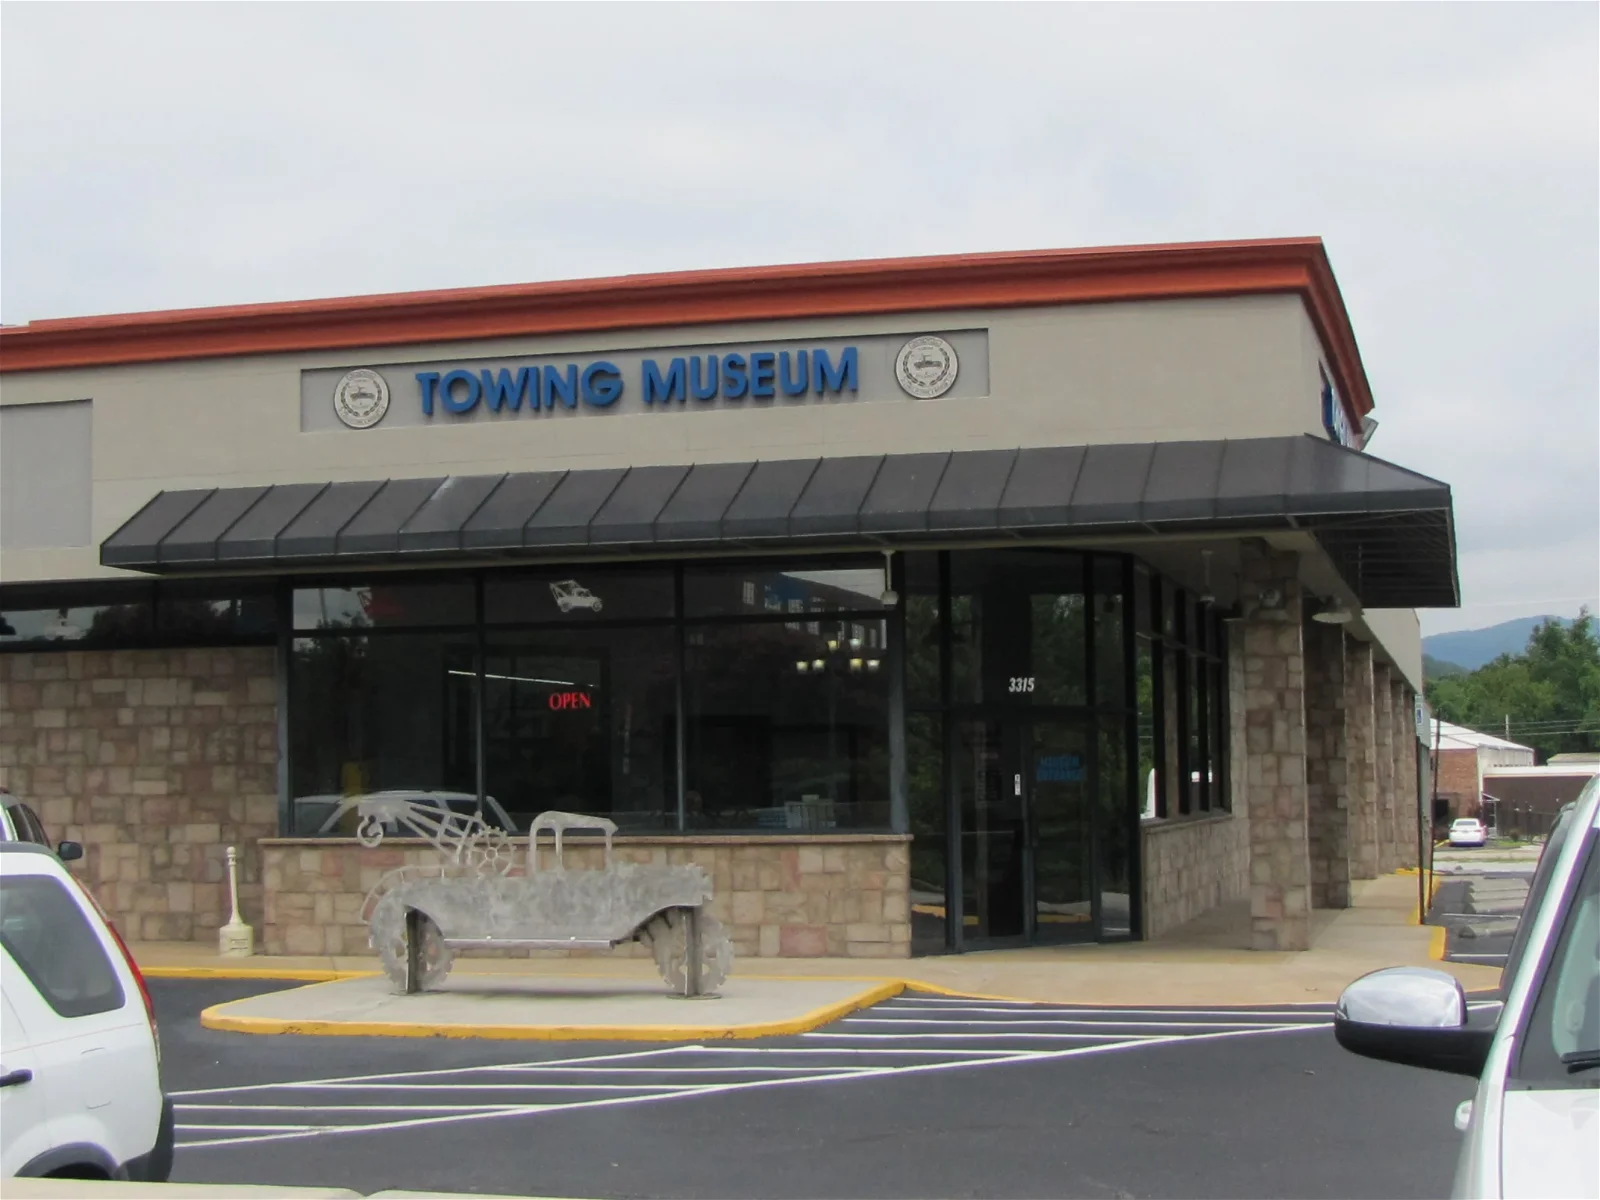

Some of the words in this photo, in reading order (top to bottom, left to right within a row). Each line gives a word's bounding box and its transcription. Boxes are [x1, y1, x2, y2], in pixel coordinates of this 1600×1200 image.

[415, 361, 624, 416] TOWING
[641, 346, 859, 405] MUSEUM
[1008, 676, 1036, 693] 3315
[548, 692, 592, 711] OPEN
